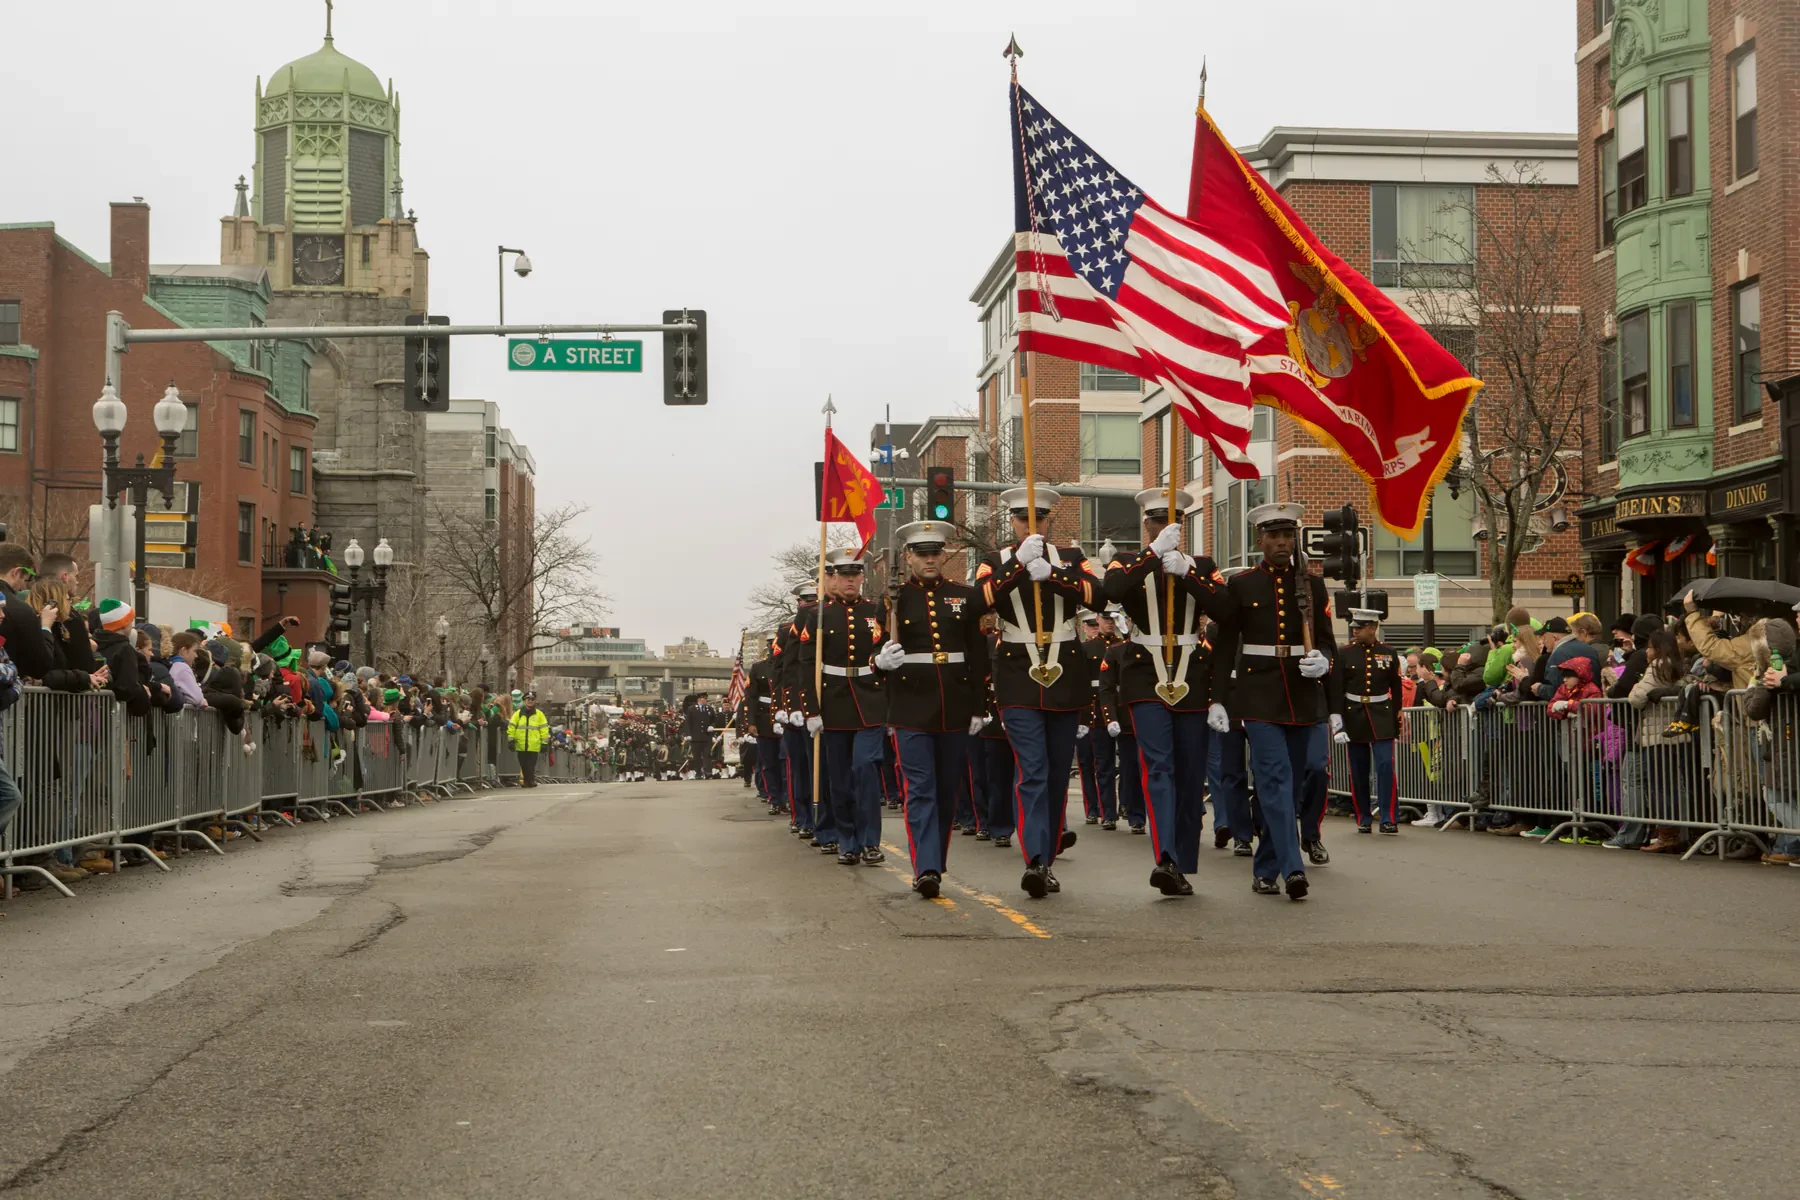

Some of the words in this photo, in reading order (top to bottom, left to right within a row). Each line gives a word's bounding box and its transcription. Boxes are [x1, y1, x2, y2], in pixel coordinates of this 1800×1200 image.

[543, 347, 557, 364] A
[566, 347, 635, 365] STREET
[1338, 407, 1376, 440] MARINE
[1383, 457, 1406, 476] RPS
[1726, 482, 1767, 509] DINING
